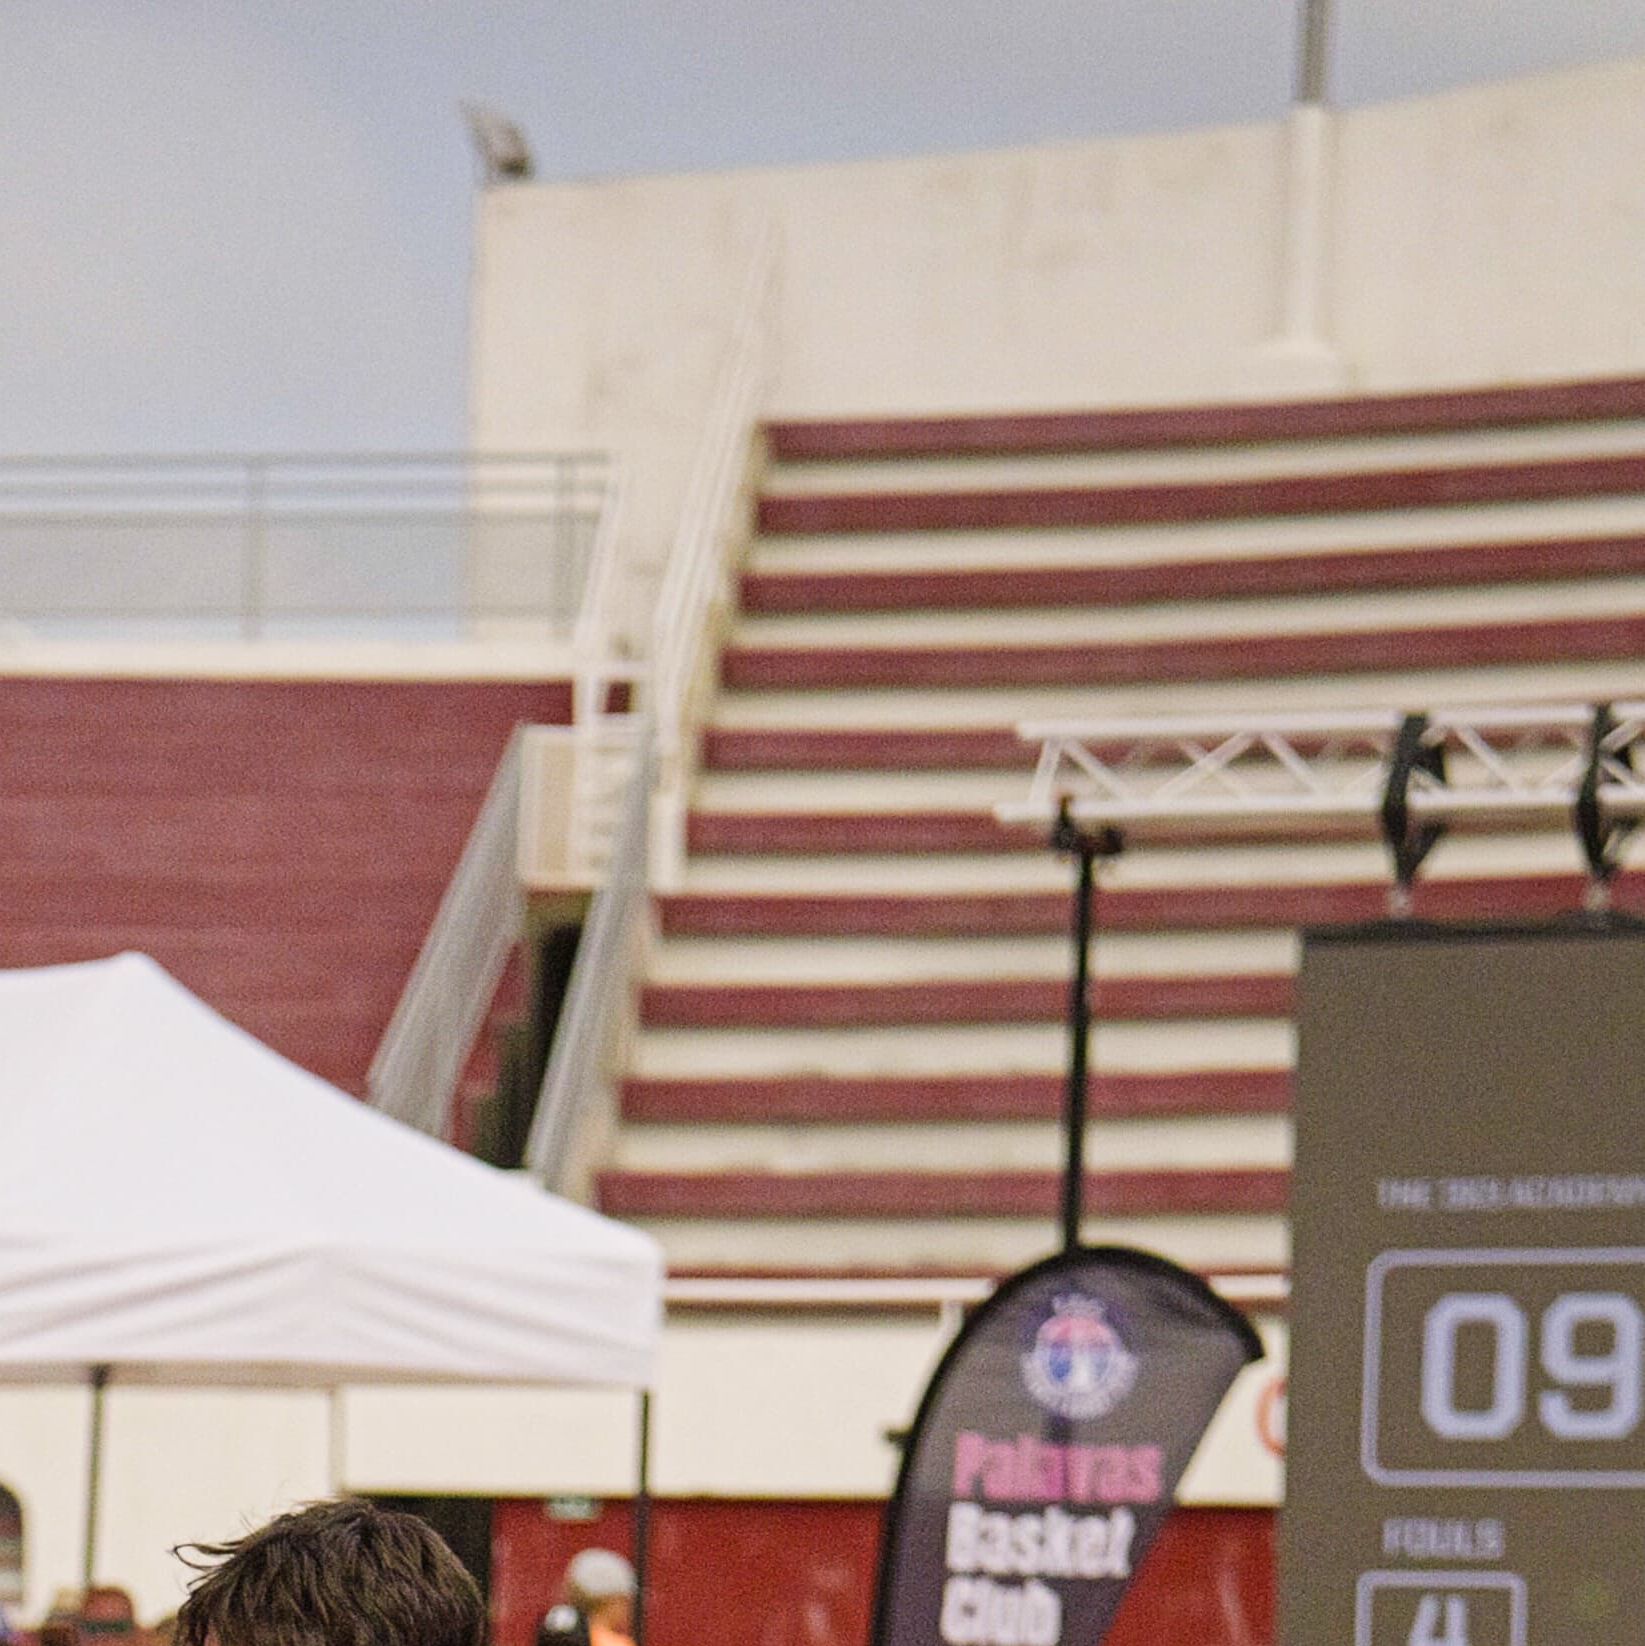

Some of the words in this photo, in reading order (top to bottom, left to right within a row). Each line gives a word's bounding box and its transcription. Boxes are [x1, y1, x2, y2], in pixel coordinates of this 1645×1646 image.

[1421, 1290, 1643, 1441] 09
[953, 1430, 1161, 1504] Palavas
[946, 1501, 1136, 1579] Basket
[1382, 1517, 1505, 1559] FOULS
